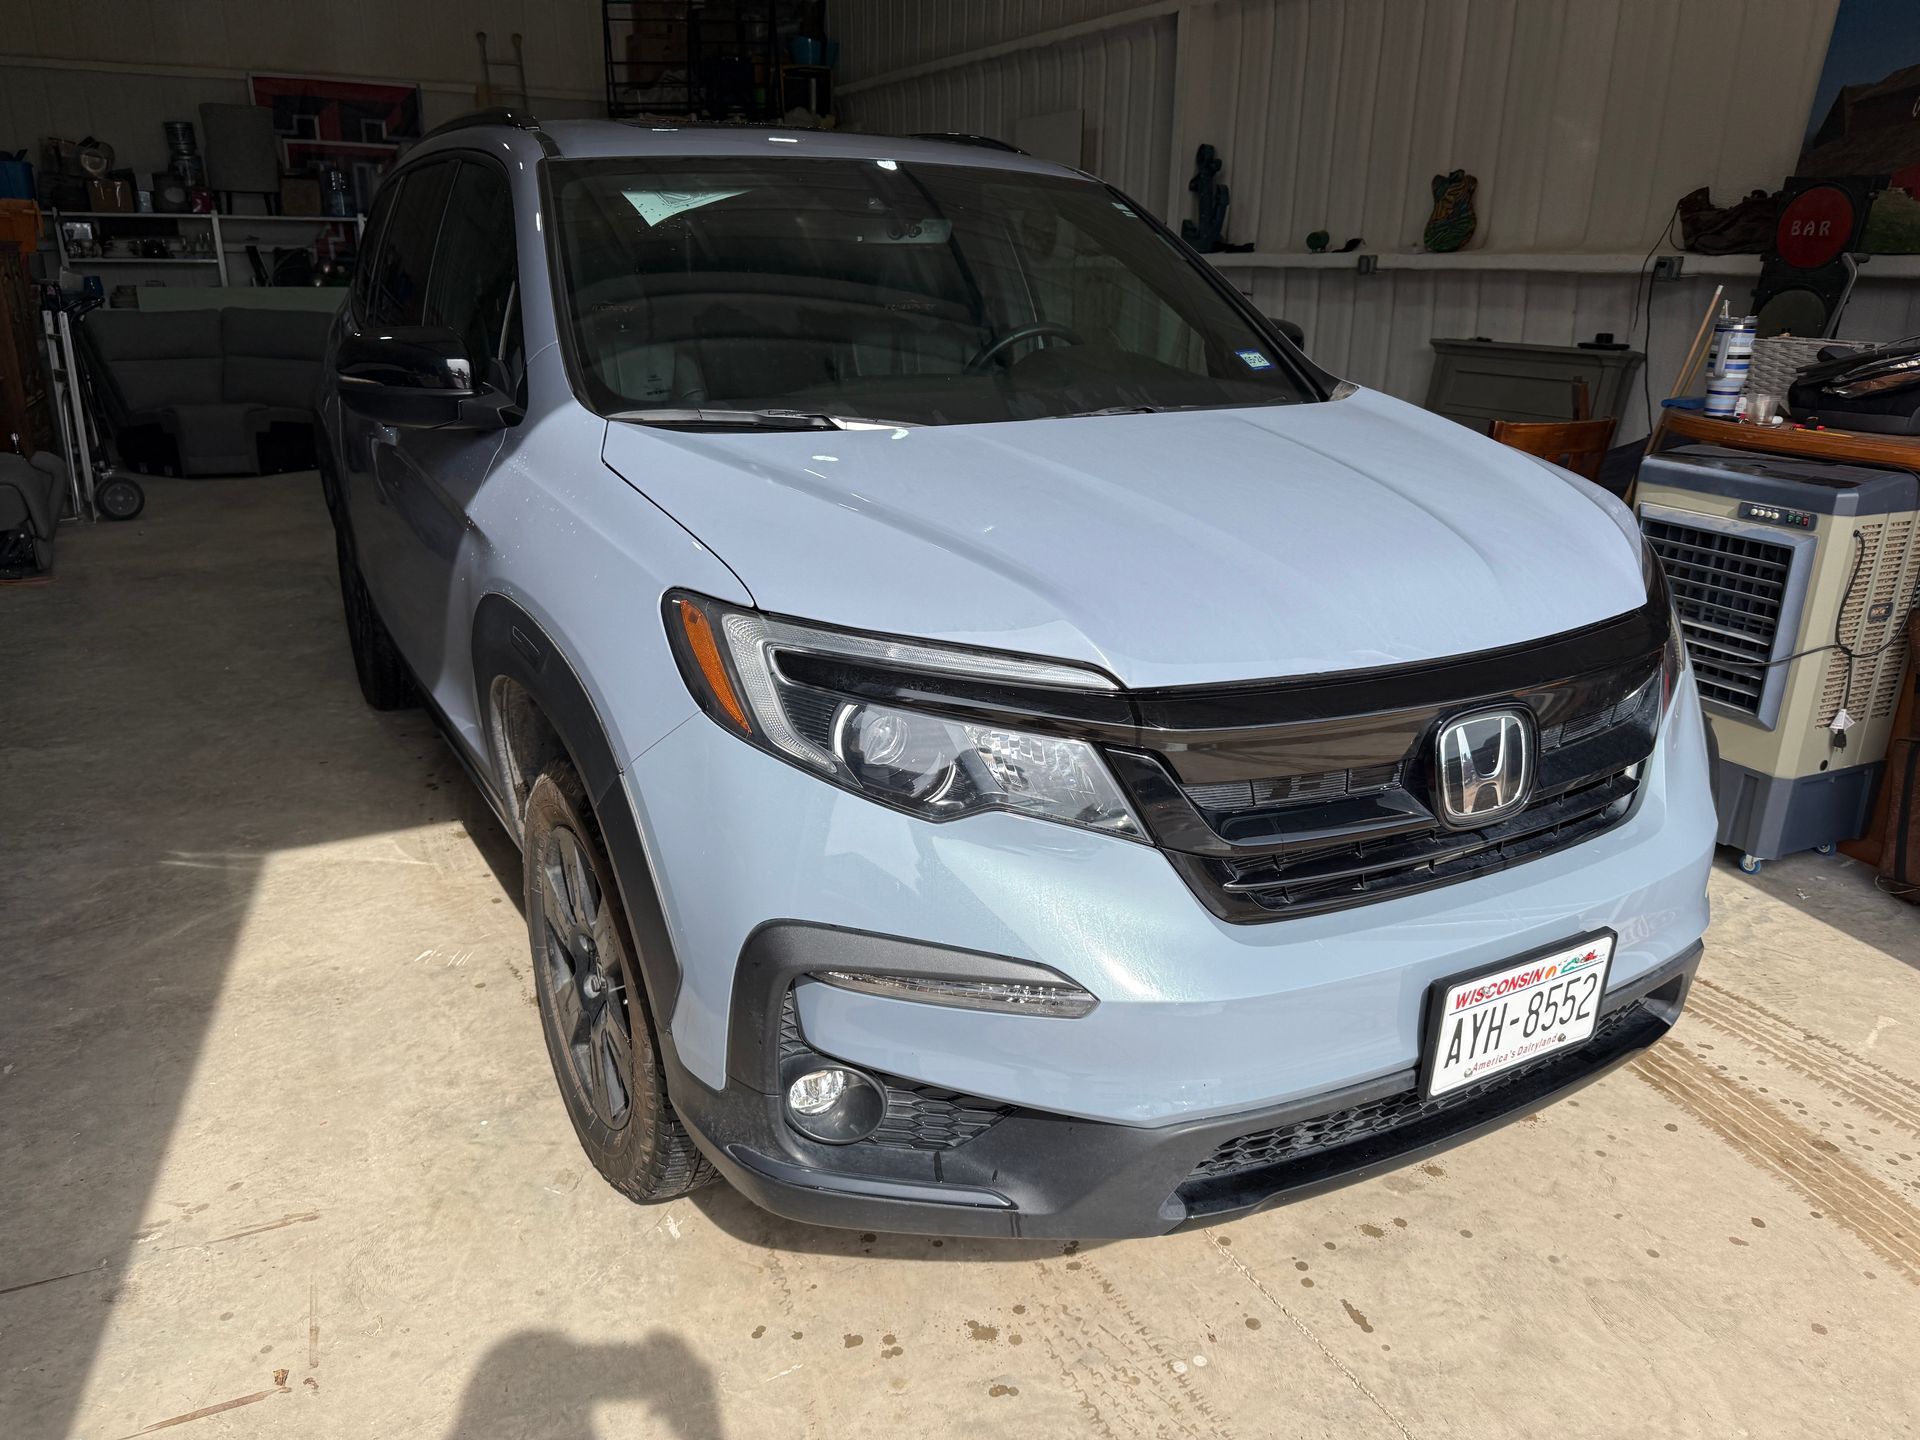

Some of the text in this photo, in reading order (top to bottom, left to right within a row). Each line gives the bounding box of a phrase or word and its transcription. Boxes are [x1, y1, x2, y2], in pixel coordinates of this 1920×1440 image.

[1791, 220, 1831, 236] BAR
[1455, 966, 1546, 1010] WISCONSIN
[1443, 972, 1598, 1069] AYH-8552
[1472, 1033, 1559, 1072] America's Dairyland
